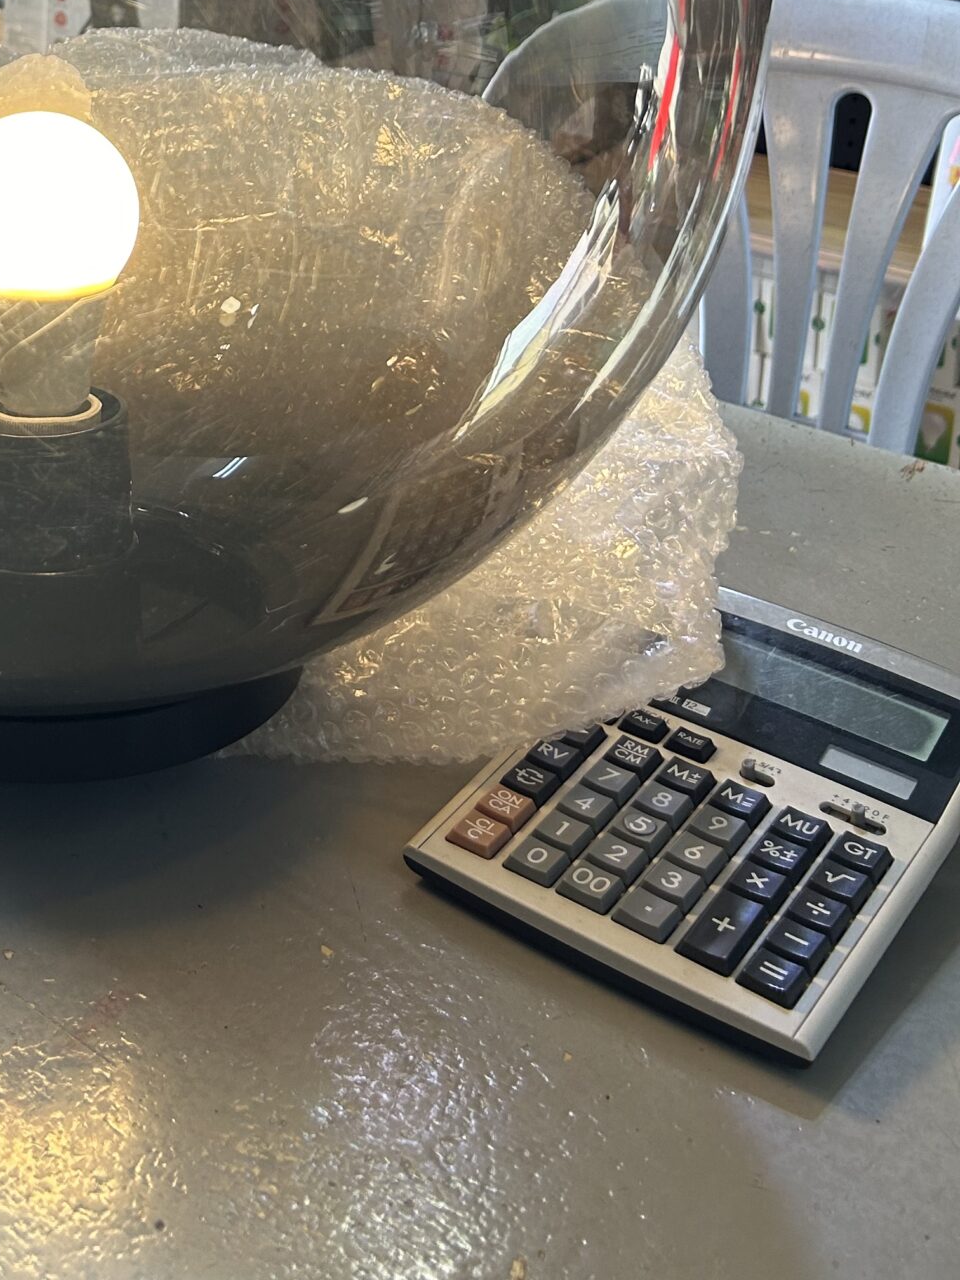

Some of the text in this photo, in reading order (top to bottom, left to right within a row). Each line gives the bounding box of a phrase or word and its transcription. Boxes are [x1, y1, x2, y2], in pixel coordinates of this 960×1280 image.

[787, 618, 863, 654] Canon
[677, 731, 705, 746] RATE
[537, 742, 570, 761] RV
[622, 739, 650, 757] RM
[613, 748, 643, 766] CM
[597, 767, 622, 782] 7
[497, 789, 524, 806] ON
[574, 797, 596, 811] 4
[651, 791, 673, 808] 8
[488, 799, 512, 815] CA
[555, 821, 571, 836] 1
[629, 816, 653, 833] 5
[707, 816, 729, 832] 9
[779, 813, 820, 836] MU
[466, 827, 483, 840] C
[526, 847, 548, 864] 0
[604, 844, 628, 863] 2
[683, 845, 705, 860] 6
[843, 841, 878, 860] GT
[572, 867, 611, 893] 00
[660, 871, 683, 889] 3
